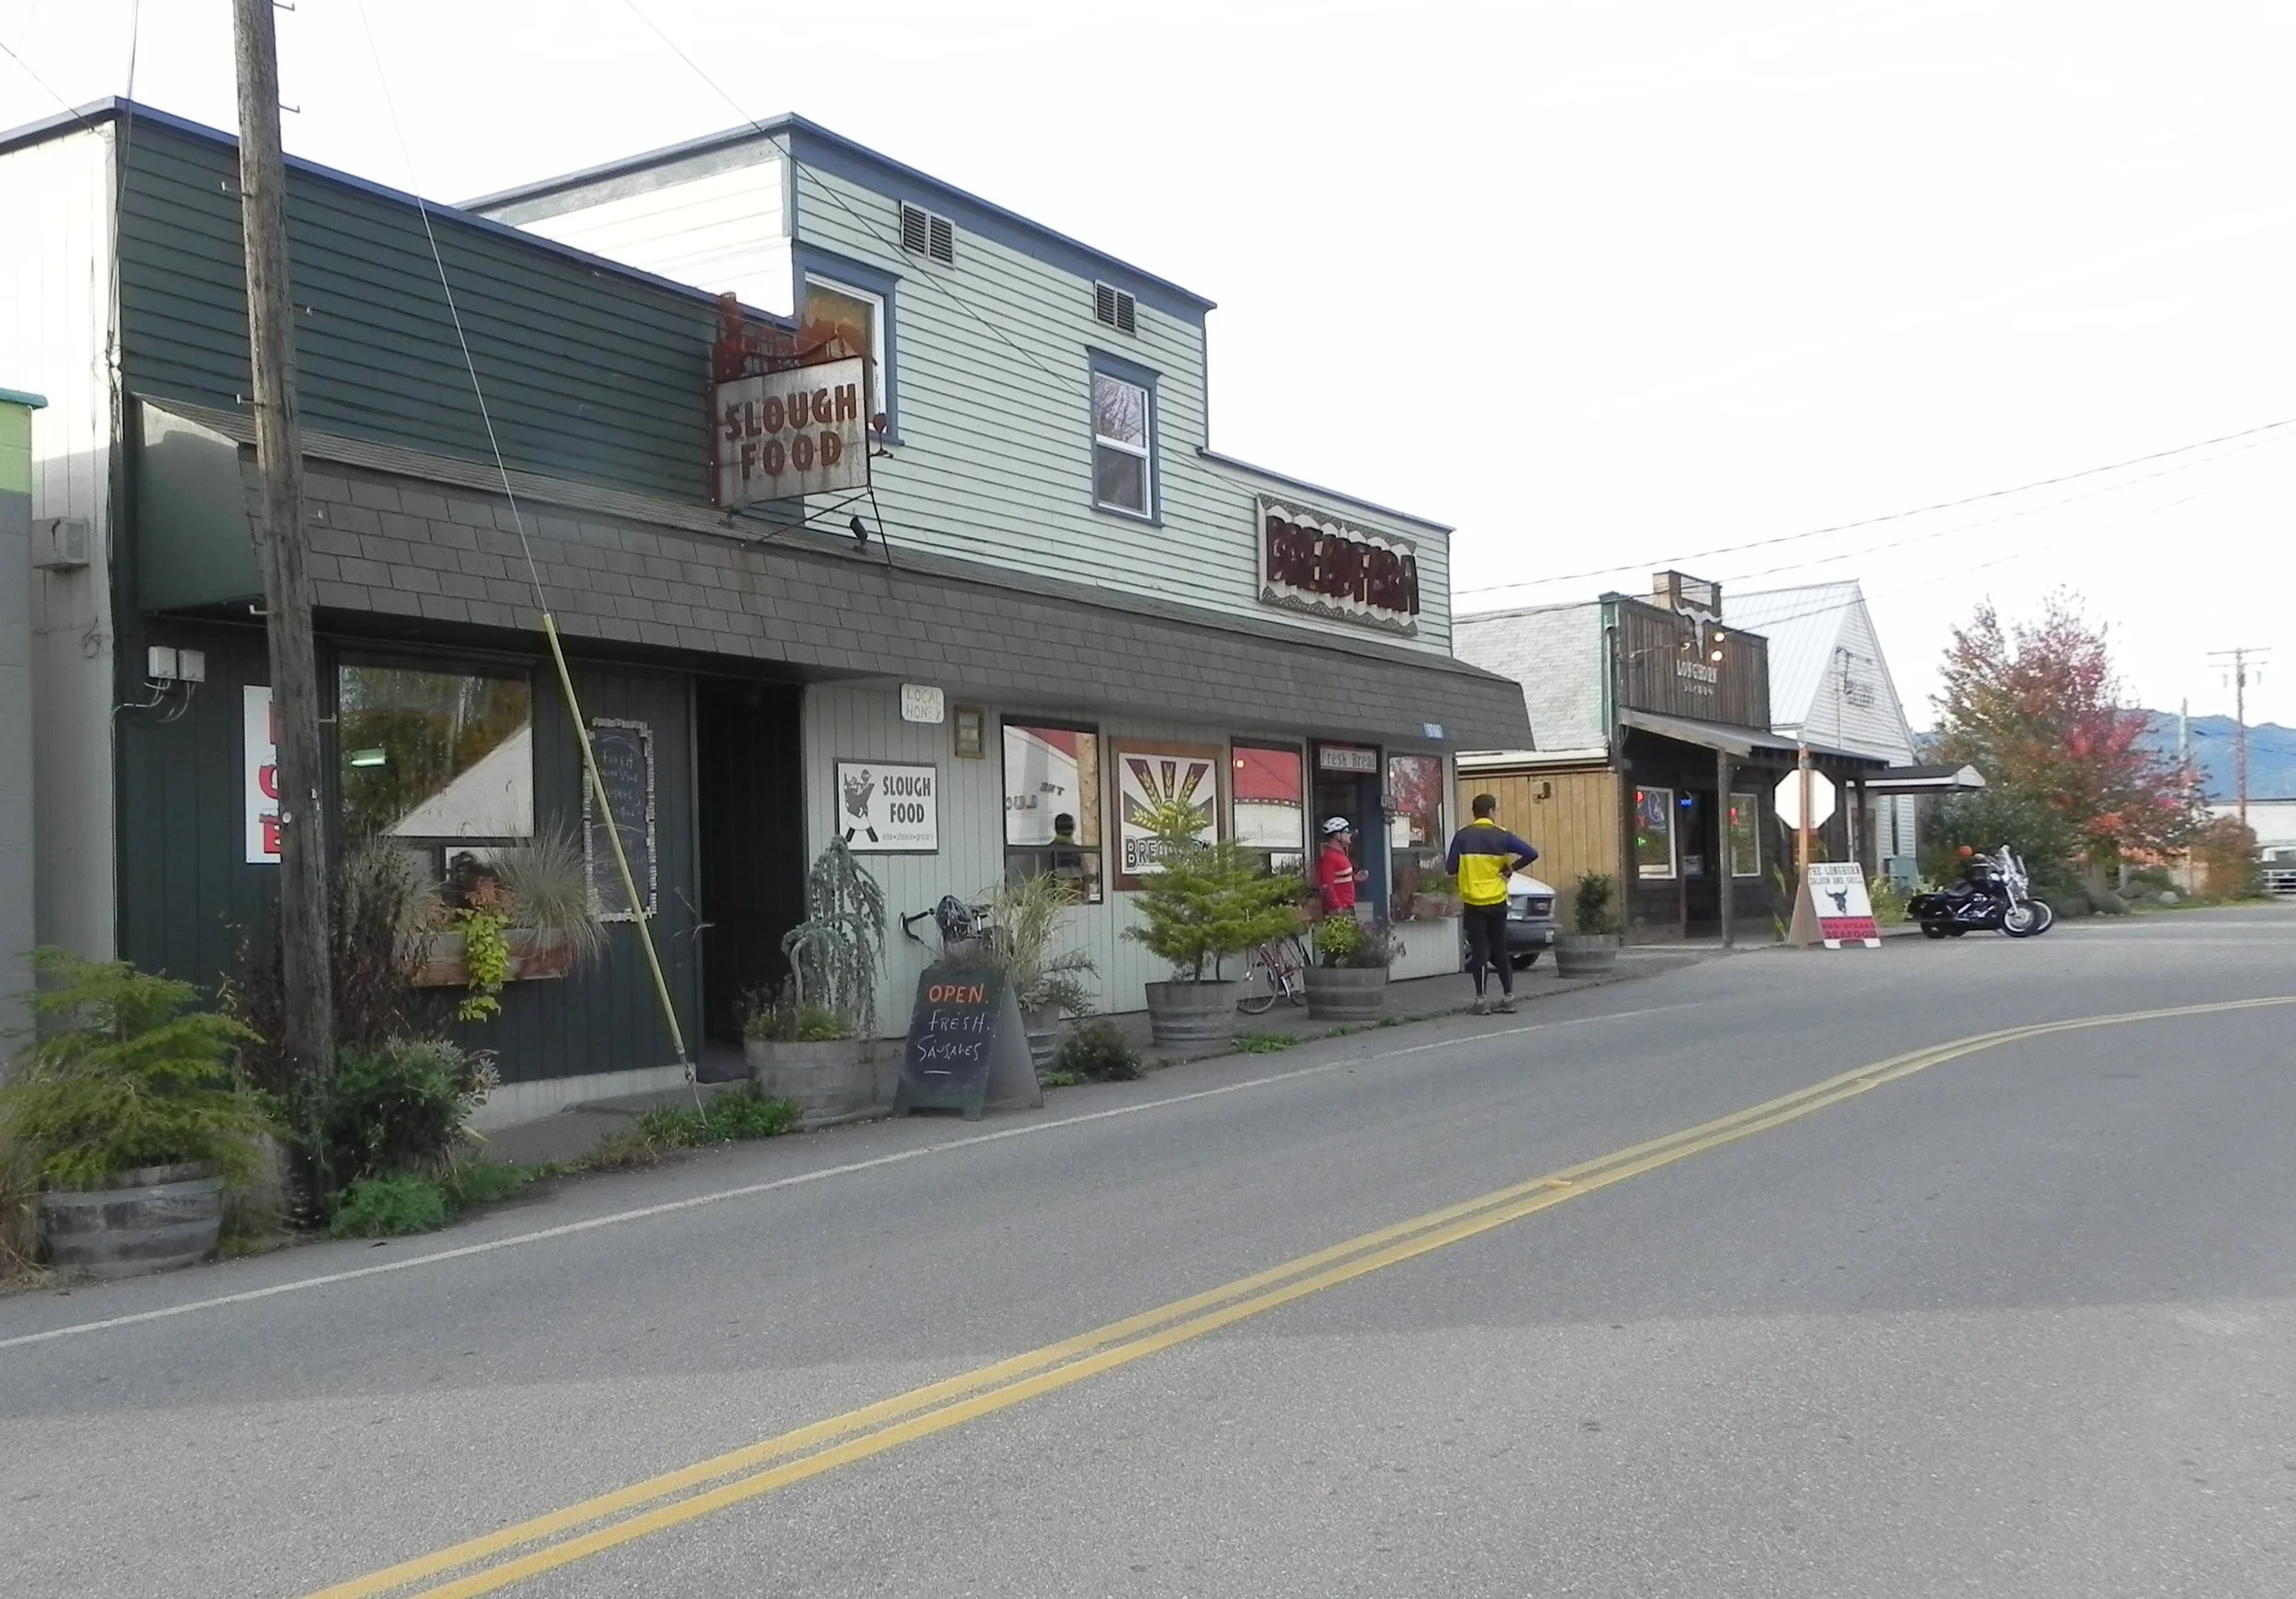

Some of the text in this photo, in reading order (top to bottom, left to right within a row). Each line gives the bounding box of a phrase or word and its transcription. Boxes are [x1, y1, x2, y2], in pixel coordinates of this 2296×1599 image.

[724, 383, 857, 442] SLOUGH
[740, 431, 841, 479] FOOD
[906, 687, 942, 705] LOCAL
[906, 704, 941, 721] HONEY
[1321, 749, 1347, 768] Fresh
[883, 774, 931, 797] SLOUGH
[889, 802, 925, 824] FOOD
[929, 983, 985, 1004] OPEN
[929, 1009, 985, 1033] FRESH
